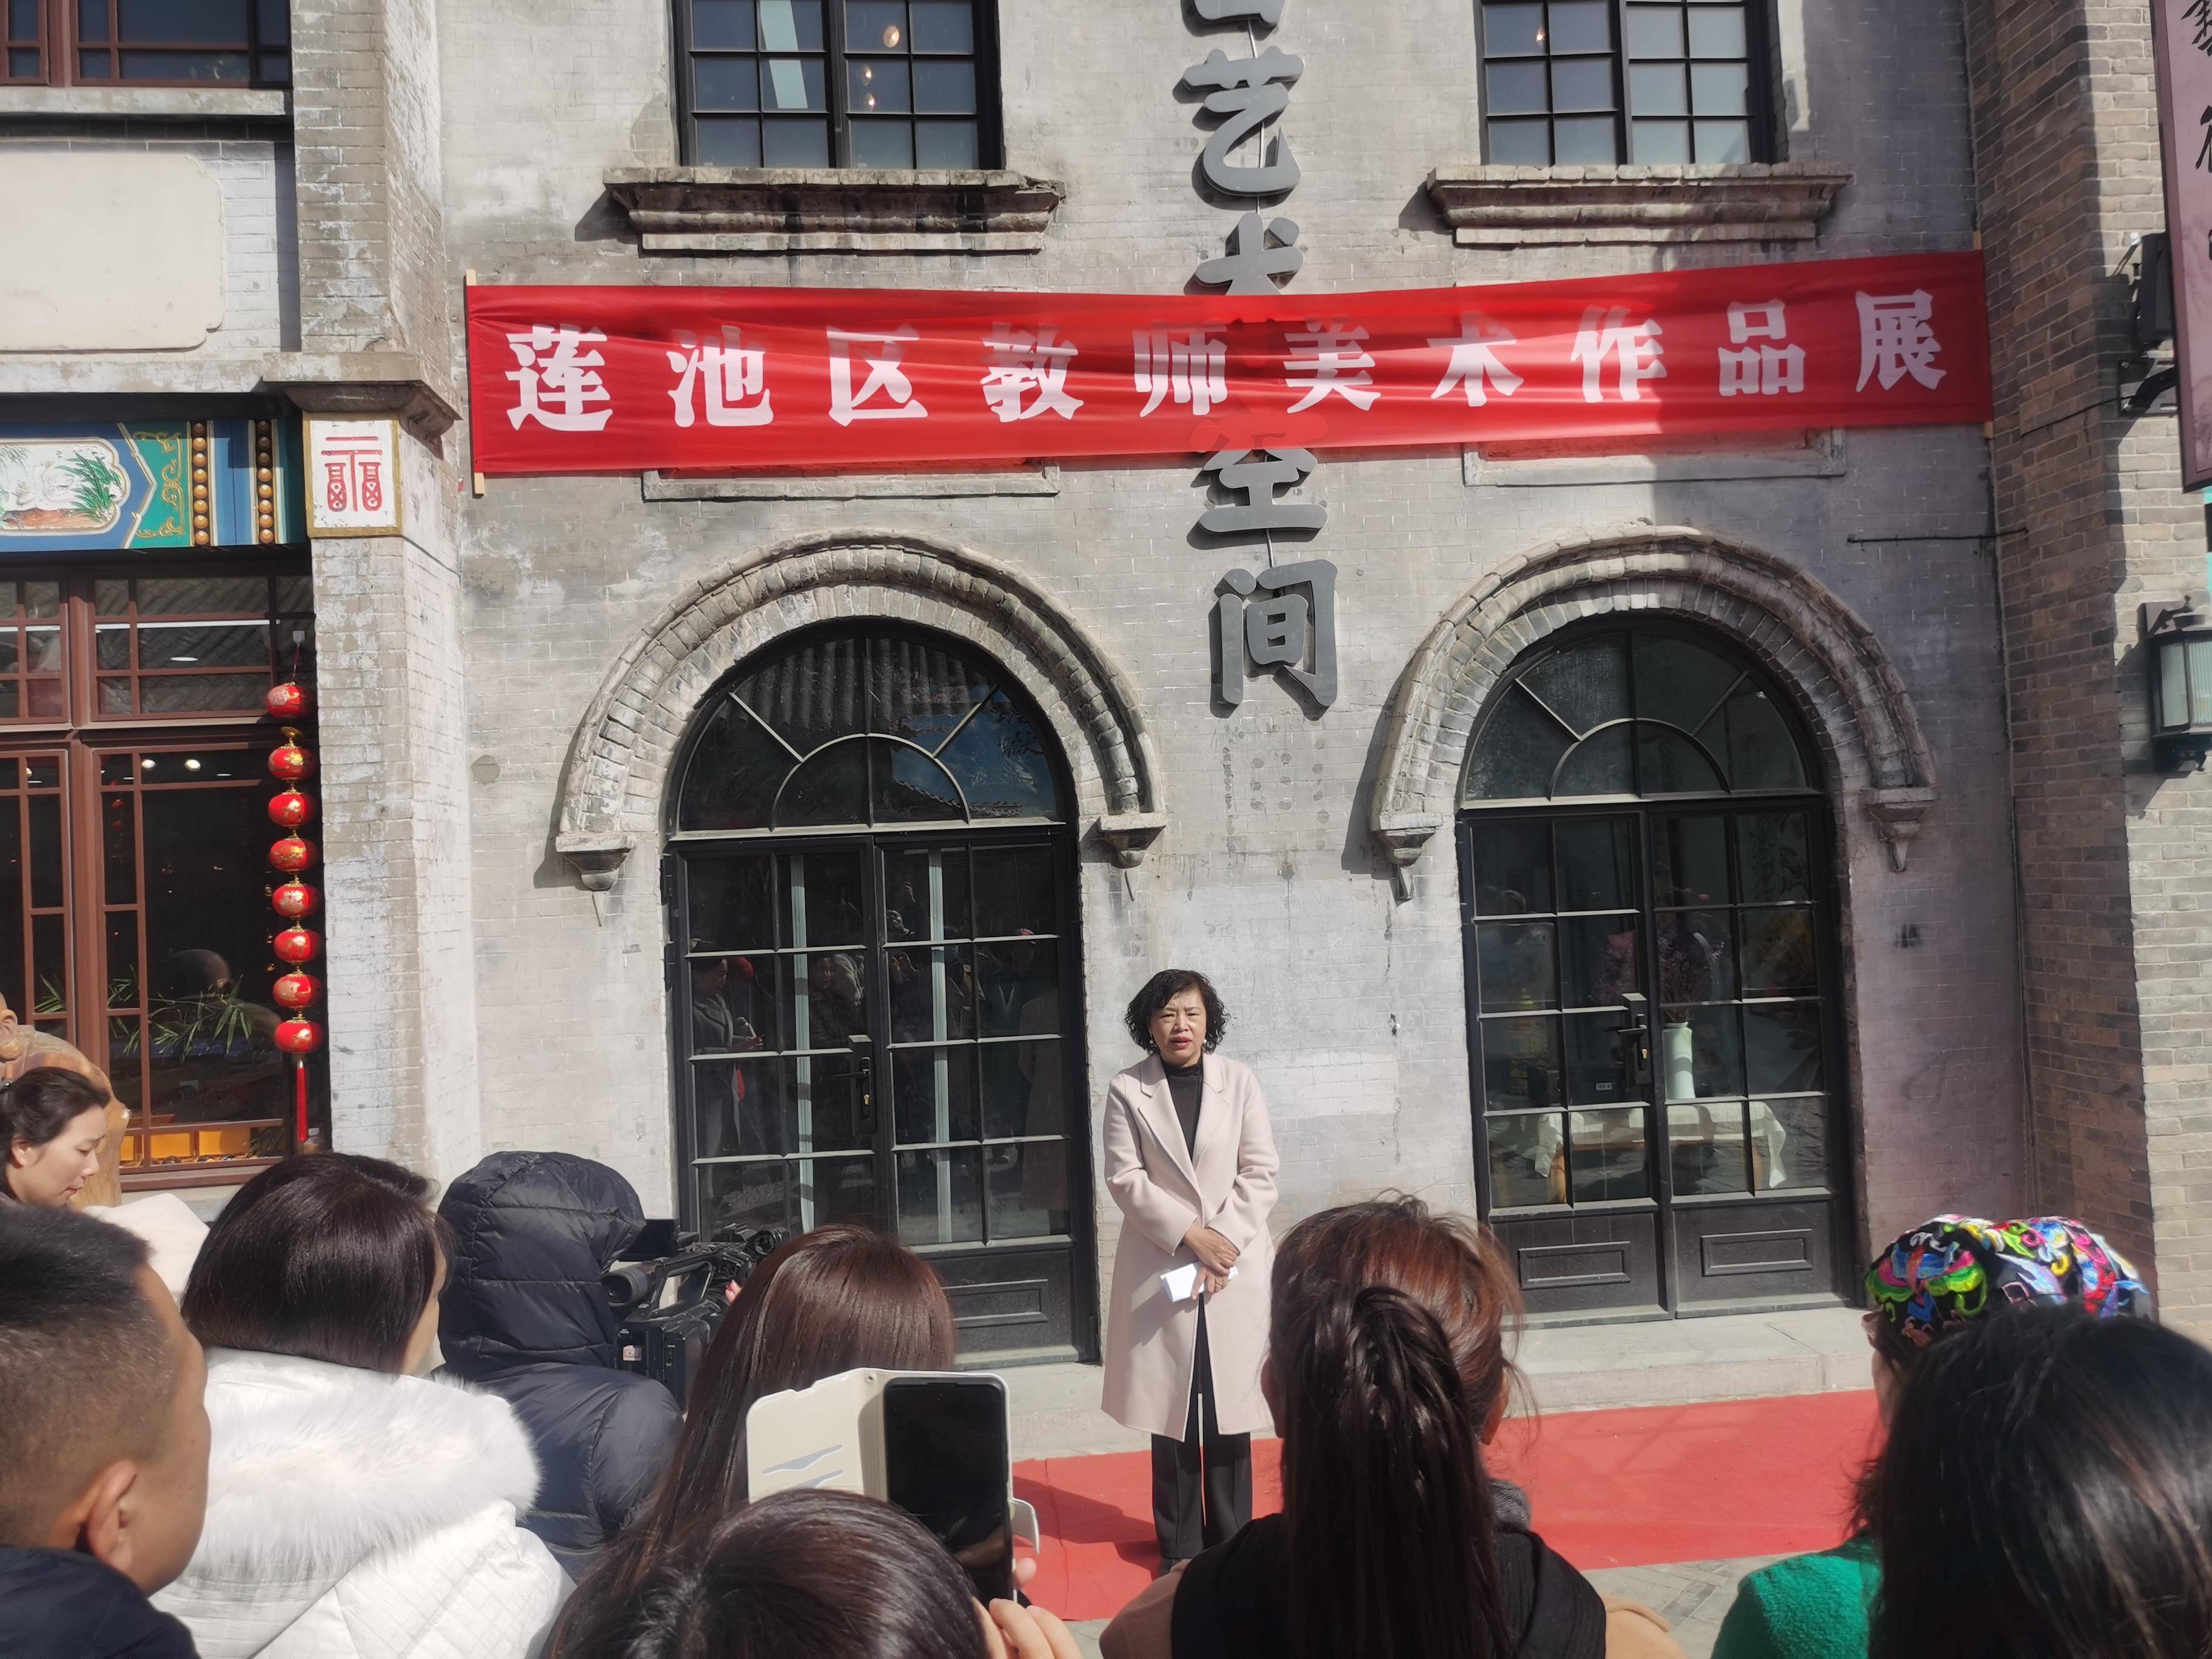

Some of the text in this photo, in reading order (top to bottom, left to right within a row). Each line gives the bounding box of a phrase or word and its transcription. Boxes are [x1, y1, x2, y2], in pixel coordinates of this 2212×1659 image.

[504, 289, 1947, 431] 莲池区教师美术作品展
